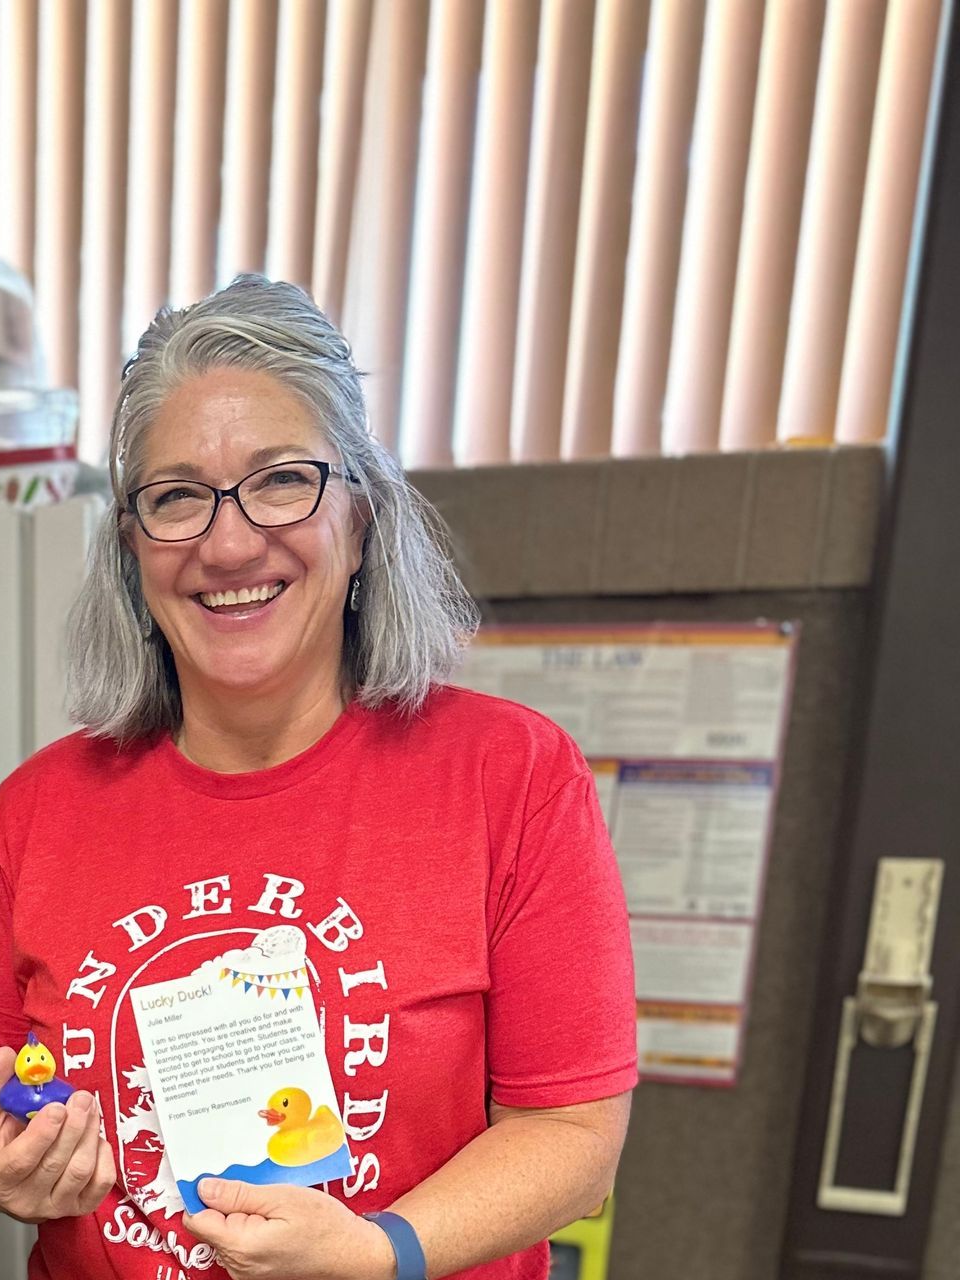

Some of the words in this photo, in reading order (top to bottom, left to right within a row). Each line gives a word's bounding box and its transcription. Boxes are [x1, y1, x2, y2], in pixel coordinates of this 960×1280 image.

[140, 995, 174, 1011] Lucky
[177, 985, 212, 1002] Duck!
[62, 872, 390, 1198] UNDERBIRDS
[147, 1018, 162, 1027] Julie
[164, 1014, 182, 1023] Miller
[153, 1047, 168, 1056] your
[201, 1036, 216, 1044] You
[217, 1033, 228, 1041] are
[229, 1026, 257, 1037] creative
[258, 1022, 271, 1031] and
[273, 1018, 293, 1027] make
[177, 1027, 212, 1039] impressed
[213, 1023, 227, 1032] with
[229, 1020, 237, 1028] all
[238, 1018, 251, 1026] you
[274, 1008, 287, 1017] and
[289, 1005, 304, 1014] with
[155, 1054, 182, 1065] learning
[193, 1044, 224, 1056] engaging
[257, 1028, 288, 1041] Students
[158, 1063, 181, 1074] excited
[191, 1059, 201, 1067] get
[211, 1051, 233, 1060] school
[243, 1047, 252, 1055] go
[262, 1041, 277, 1050] your
[160, 1074, 178, 1083] worry
[180, 1069, 198, 1079] about
[200, 1065, 214, 1074] your
[216, 1058, 245, 1069] students
[247, 1054, 259, 1063] and
[277, 1048, 290, 1056] you
[292, 1044, 305, 1052] can
[162, 1084, 176, 1093] best
[178, 1080, 194, 1089] meet
[196, 1076, 210, 1085] their
[236, 1065, 258, 1075] Thank
[260, 1062, 272, 1070] you
[285, 1054, 305, 1064] being
[164, 1089, 198, 1102] awesome!
[168, 1112, 186, 1120] From
[186, 1107, 209, 1116] Stacey
[210, 1096, 252, 1110] Rasmussen
